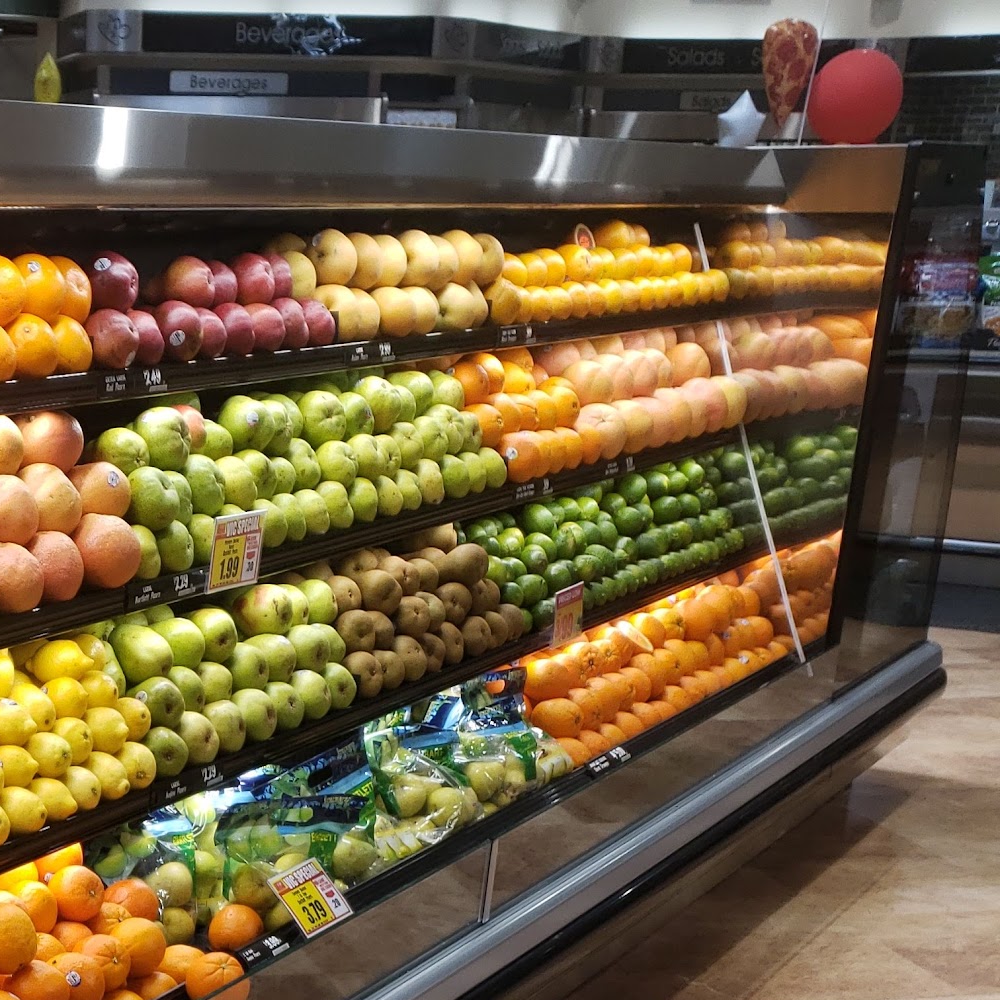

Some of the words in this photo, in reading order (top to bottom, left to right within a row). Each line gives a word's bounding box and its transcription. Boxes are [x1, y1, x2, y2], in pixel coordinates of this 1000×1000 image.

[235, 22, 339, 46] Beverage
[190, 74, 268, 91] Beverages
[220, 556, 240, 580] 1.99
[302, 900, 327, 924] 3.79
